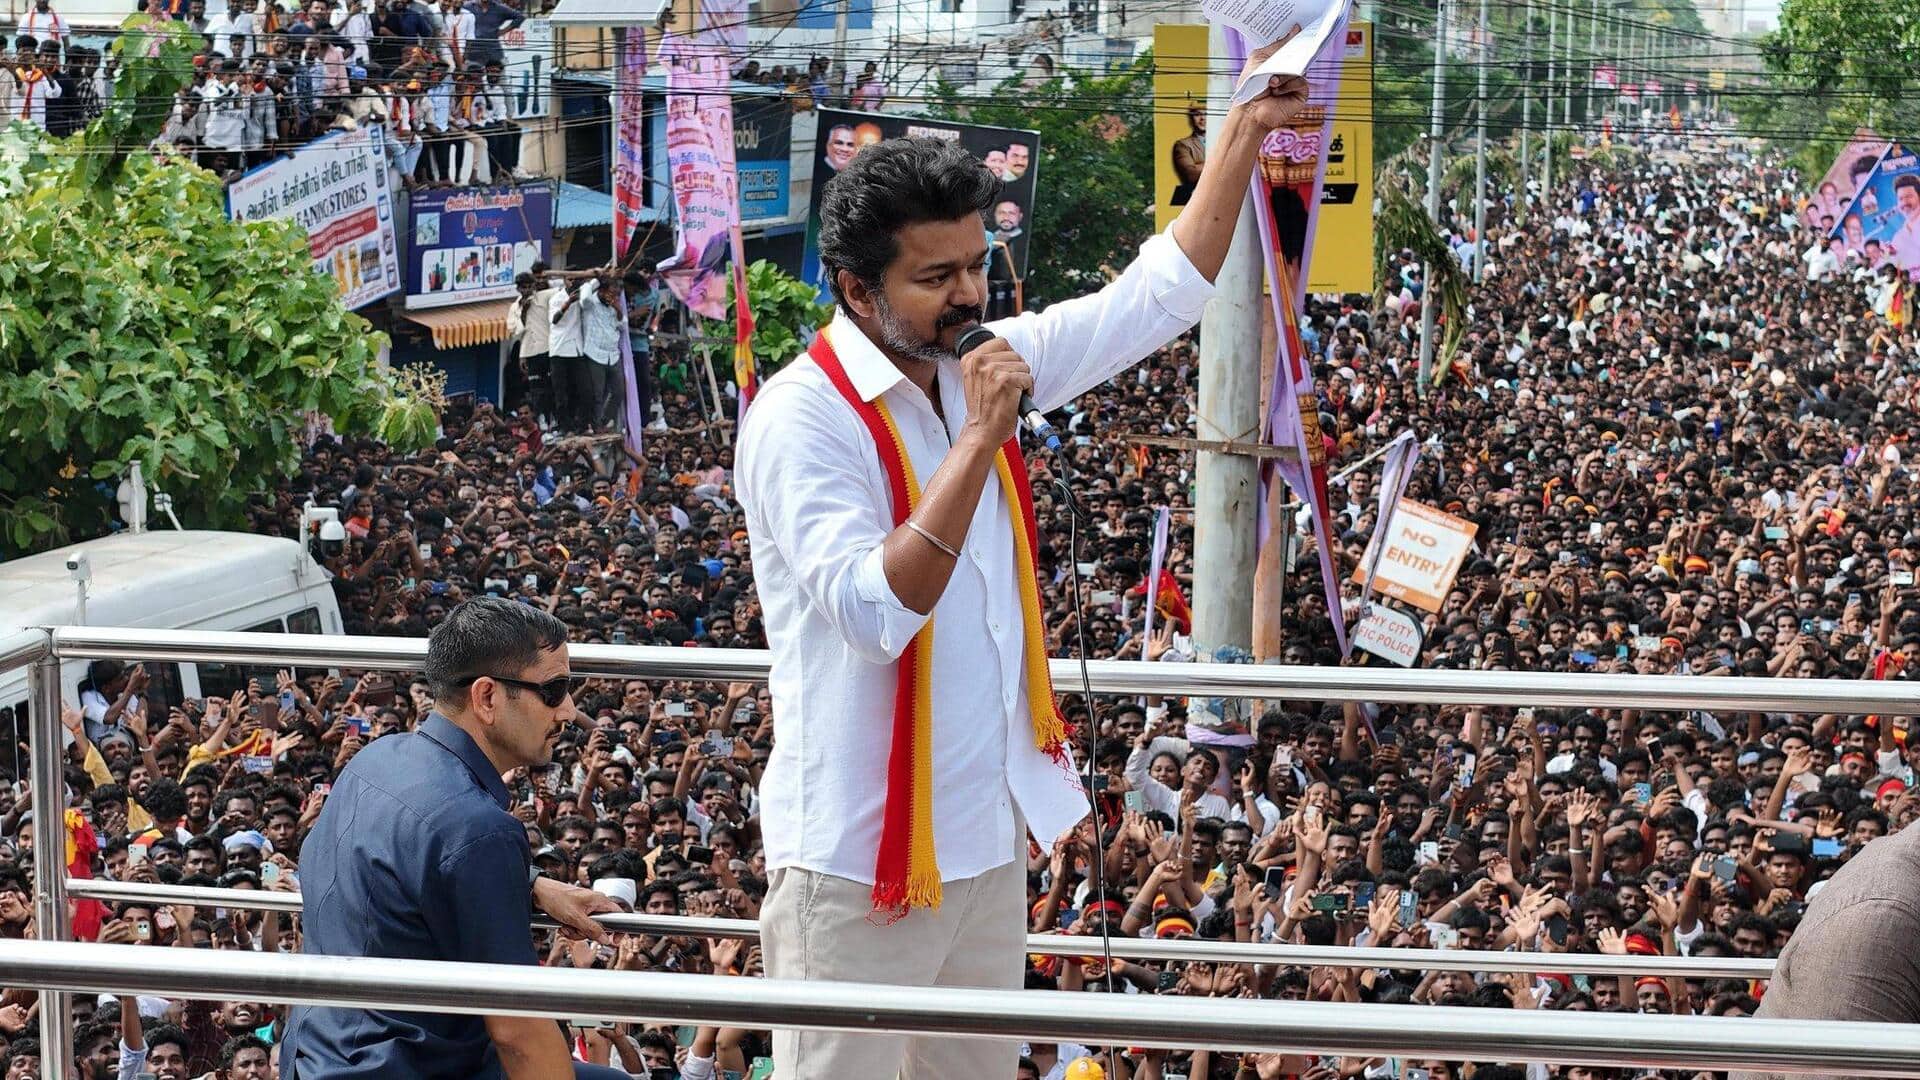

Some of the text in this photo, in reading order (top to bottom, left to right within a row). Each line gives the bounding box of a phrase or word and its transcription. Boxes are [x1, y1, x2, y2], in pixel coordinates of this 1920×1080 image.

[330, 182, 368, 216] STORES
[1401, 527, 1438, 548] NO
[1369, 613, 1413, 639] HY CITY
[1376, 633, 1415, 657] POLICE
